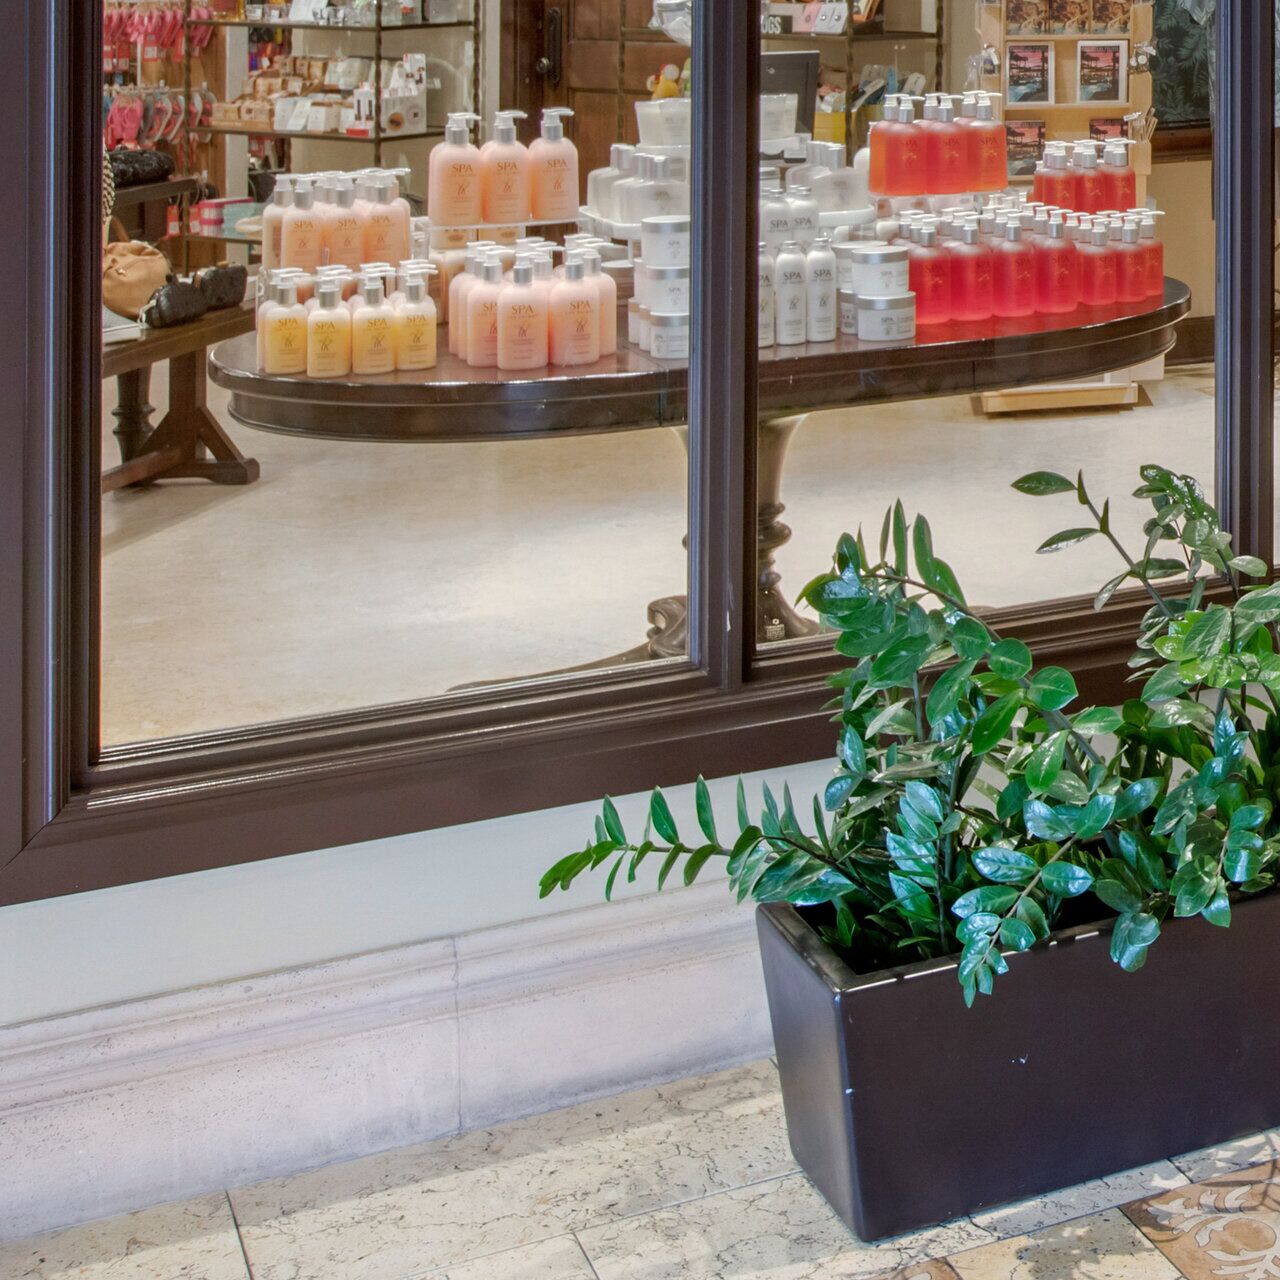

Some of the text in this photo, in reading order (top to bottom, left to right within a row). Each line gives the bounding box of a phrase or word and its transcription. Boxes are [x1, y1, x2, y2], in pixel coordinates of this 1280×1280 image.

[452, 163, 473, 173] SPA
[497, 161, 518, 171] SPA
[547, 159, 567, 168] SPA
[337, 218, 357, 227] SPA
[372, 215, 391, 224] SPA
[770, 220, 789, 228] SPA
[794, 217, 812, 226] SPA
[294, 221, 313, 230] SPA
[784, 272, 801, 280] SPA
[814, 269, 832, 278] SPA
[482, 303, 497, 312] SP
[511, 304, 534, 314] SPA
[569, 300, 591, 310] SPA
[278, 318, 298, 327] SPA
[368, 318, 387, 328] SPA
[406, 314, 426, 323] SPA
[315, 322, 335, 330] SPA
